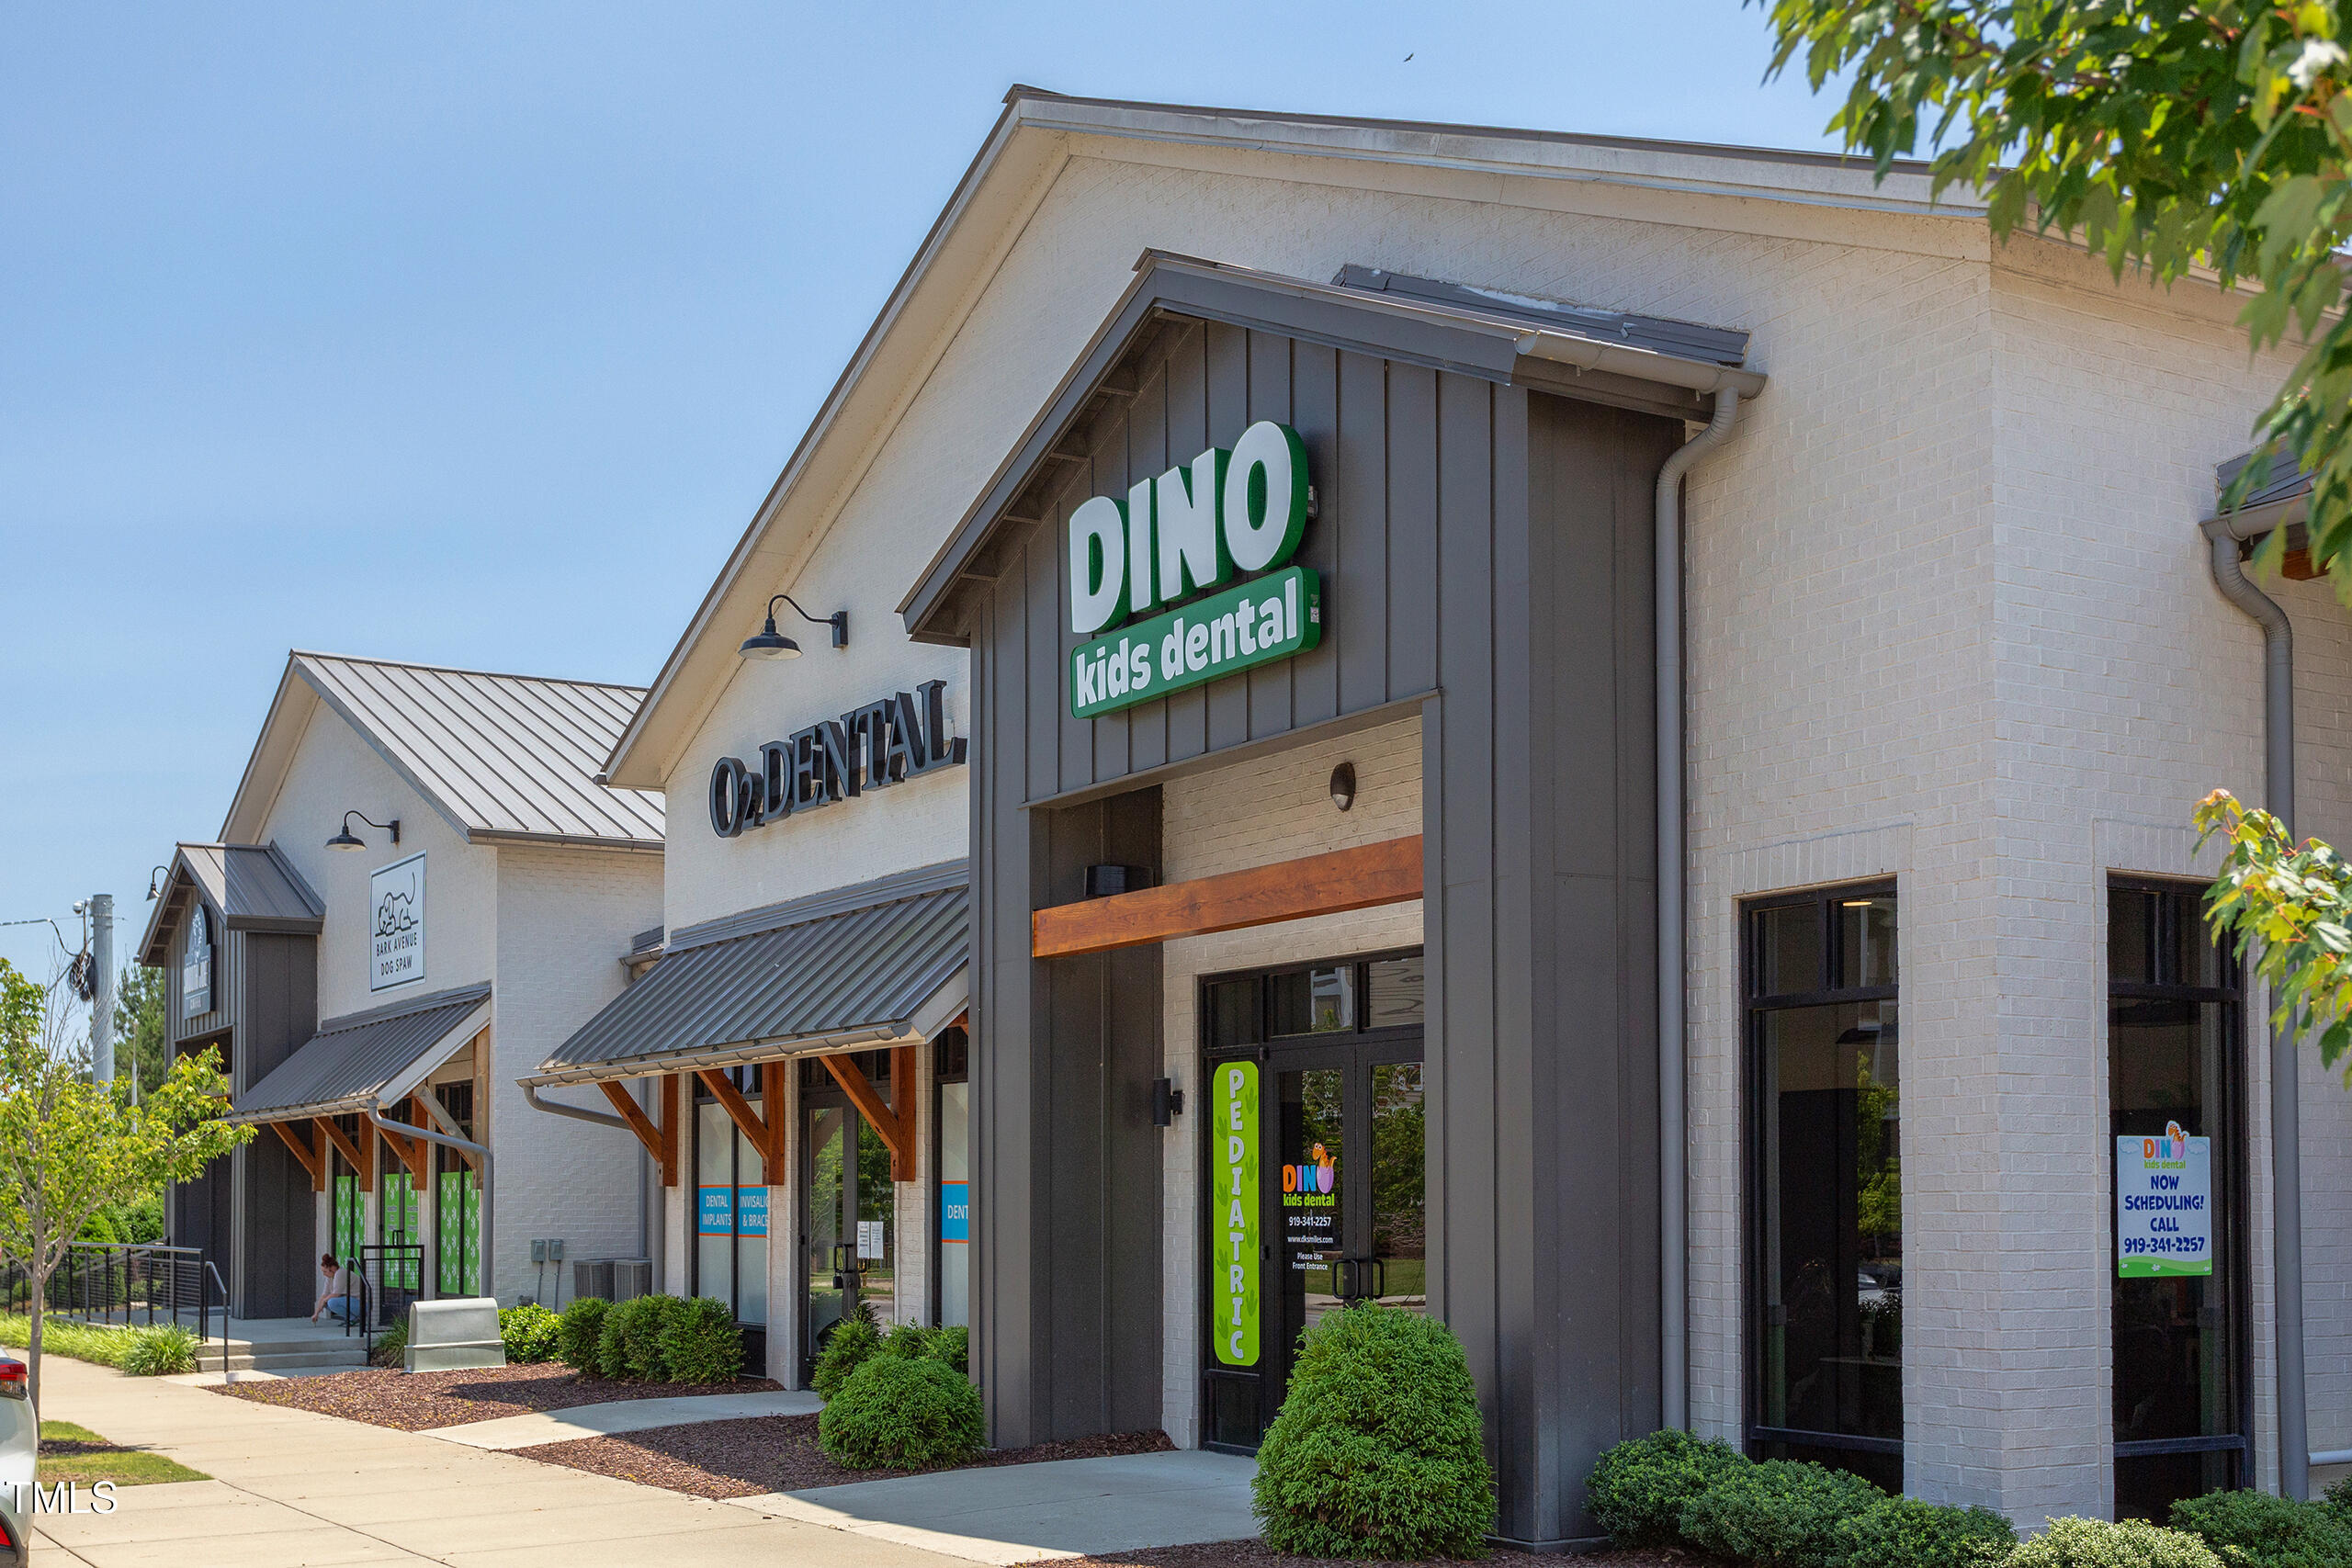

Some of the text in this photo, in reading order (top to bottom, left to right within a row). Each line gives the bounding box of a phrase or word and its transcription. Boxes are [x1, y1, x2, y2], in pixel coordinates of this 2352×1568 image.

[1069, 420, 1308, 634] DINO
[1076, 577, 1297, 708] kids dental
[377, 932, 417, 957] BARK AVENUE
[381, 955, 413, 976] DOG SPAW
[2143, 1160, 2186, 1169] kids dental
[2150, 1175, 2179, 1190] NOW
[706, 1195, 728, 1207] DENTAL
[1283, 1193, 1335, 1207] kids dental
[2124, 1195, 2204, 1211] SCHEDULING!
[702, 1213, 731, 1226] IMPLANTS
[742, 1214, 748, 1226] &
[1228, 1068, 1245, 1359] PEDIATRIC
[1288, 1216, 1331, 1226] 919-341-2257
[2150, 1217, 2179, 1232] CALL
[2124, 1236, 2205, 1253] 919-341-2257
[1296, 1252, 1313, 1260] Please
[1306, 1262, 1329, 1270] Entrance
